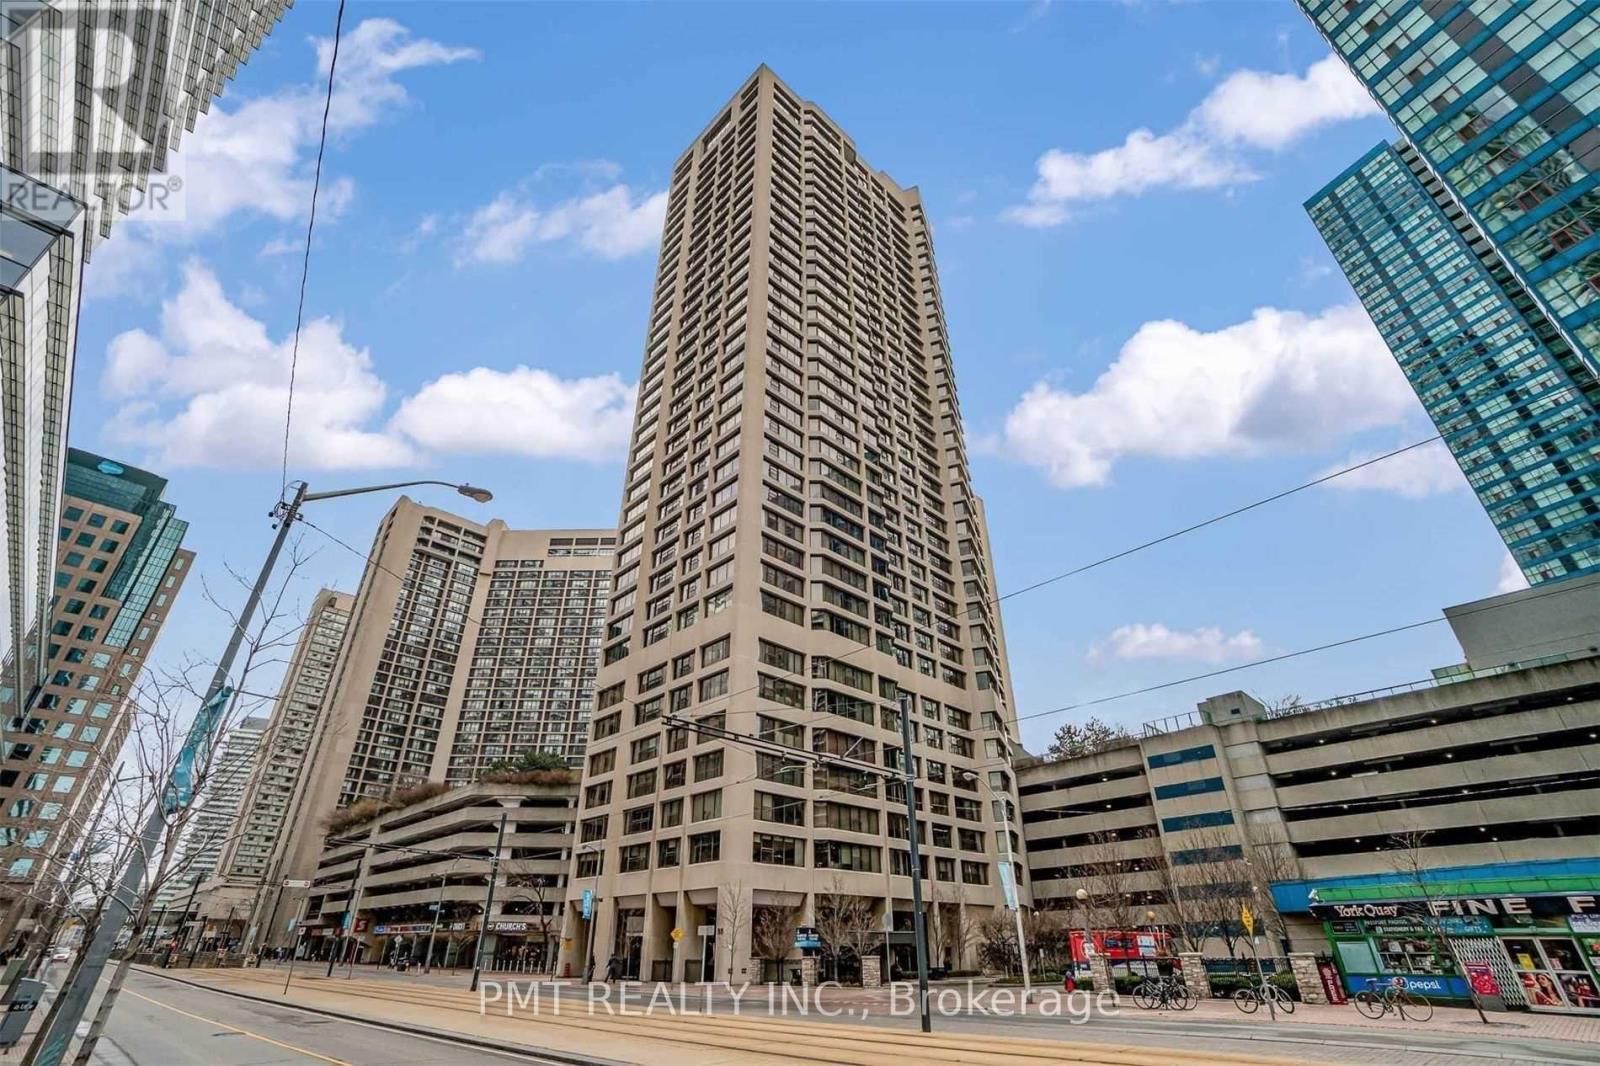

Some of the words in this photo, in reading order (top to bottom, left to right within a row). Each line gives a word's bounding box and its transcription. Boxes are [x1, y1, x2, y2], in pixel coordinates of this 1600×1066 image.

[1334, 904, 1365, 917] York
[1364, 903, 1399, 918] Quay
[1427, 897, 1533, 916] FINE
[1409, 979, 1442, 992] pepsi
